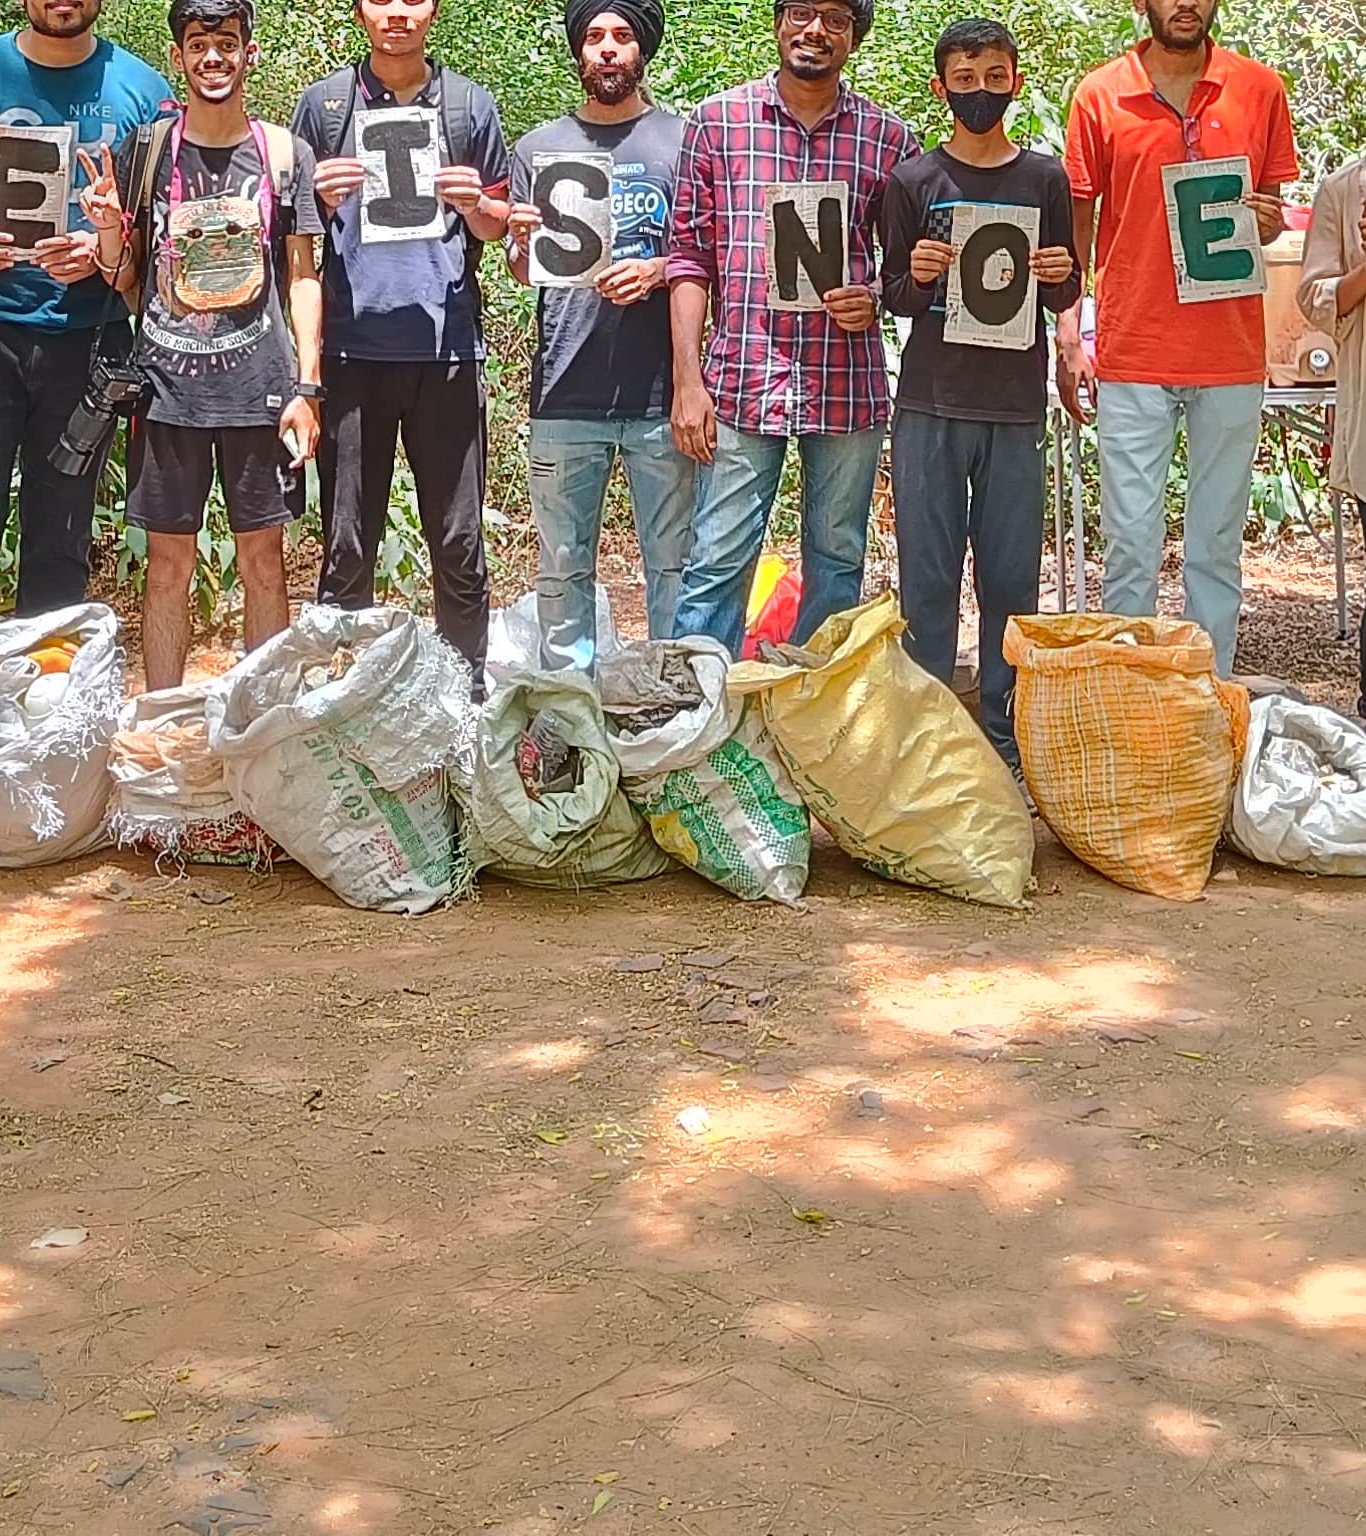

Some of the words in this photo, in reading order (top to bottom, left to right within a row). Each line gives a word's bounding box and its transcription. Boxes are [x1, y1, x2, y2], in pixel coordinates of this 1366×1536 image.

[68, 103, 113, 118] NIKE
[361, 119, 439, 228] I
[534, 160, 608, 276] S
[772, 197, 845, 302] N
[960, 222, 1030, 326] O
[1174, 174, 1255, 282] E
[327, 767, 371, 821] SOYA
